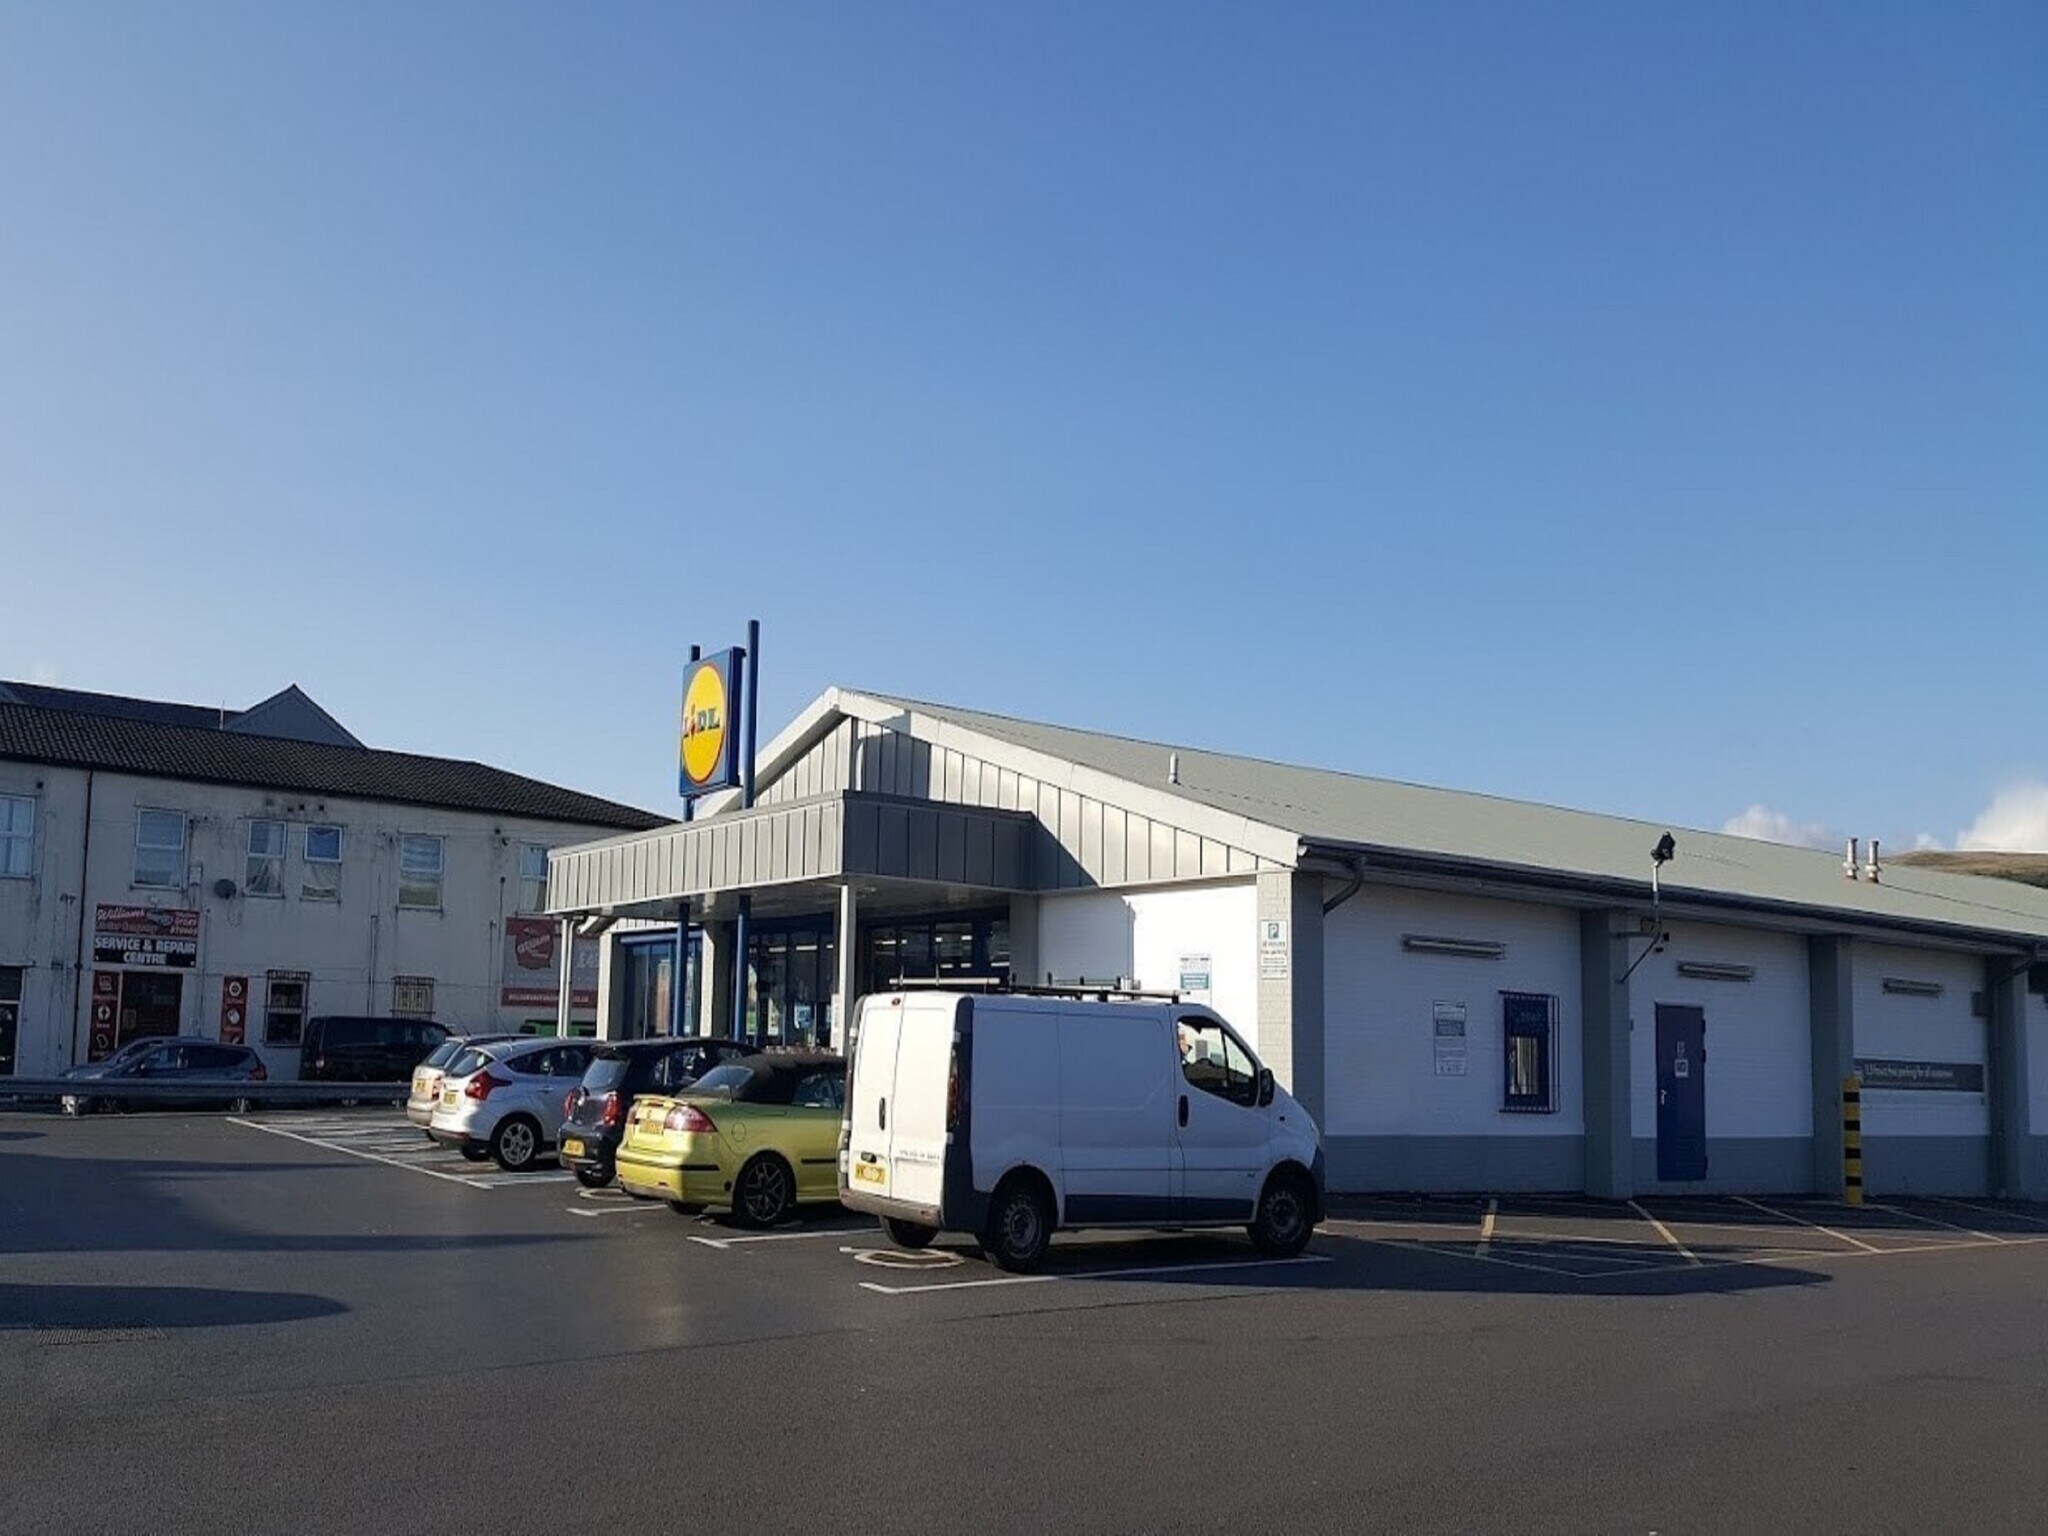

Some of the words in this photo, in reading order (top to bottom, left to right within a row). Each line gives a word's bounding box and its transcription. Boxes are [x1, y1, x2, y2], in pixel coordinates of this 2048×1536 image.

[95, 936, 141, 951] SERVICE
[143, 940, 153, 952] &
[155, 940, 196, 955] REPAIR
[123, 952, 167, 964] CENTRE
